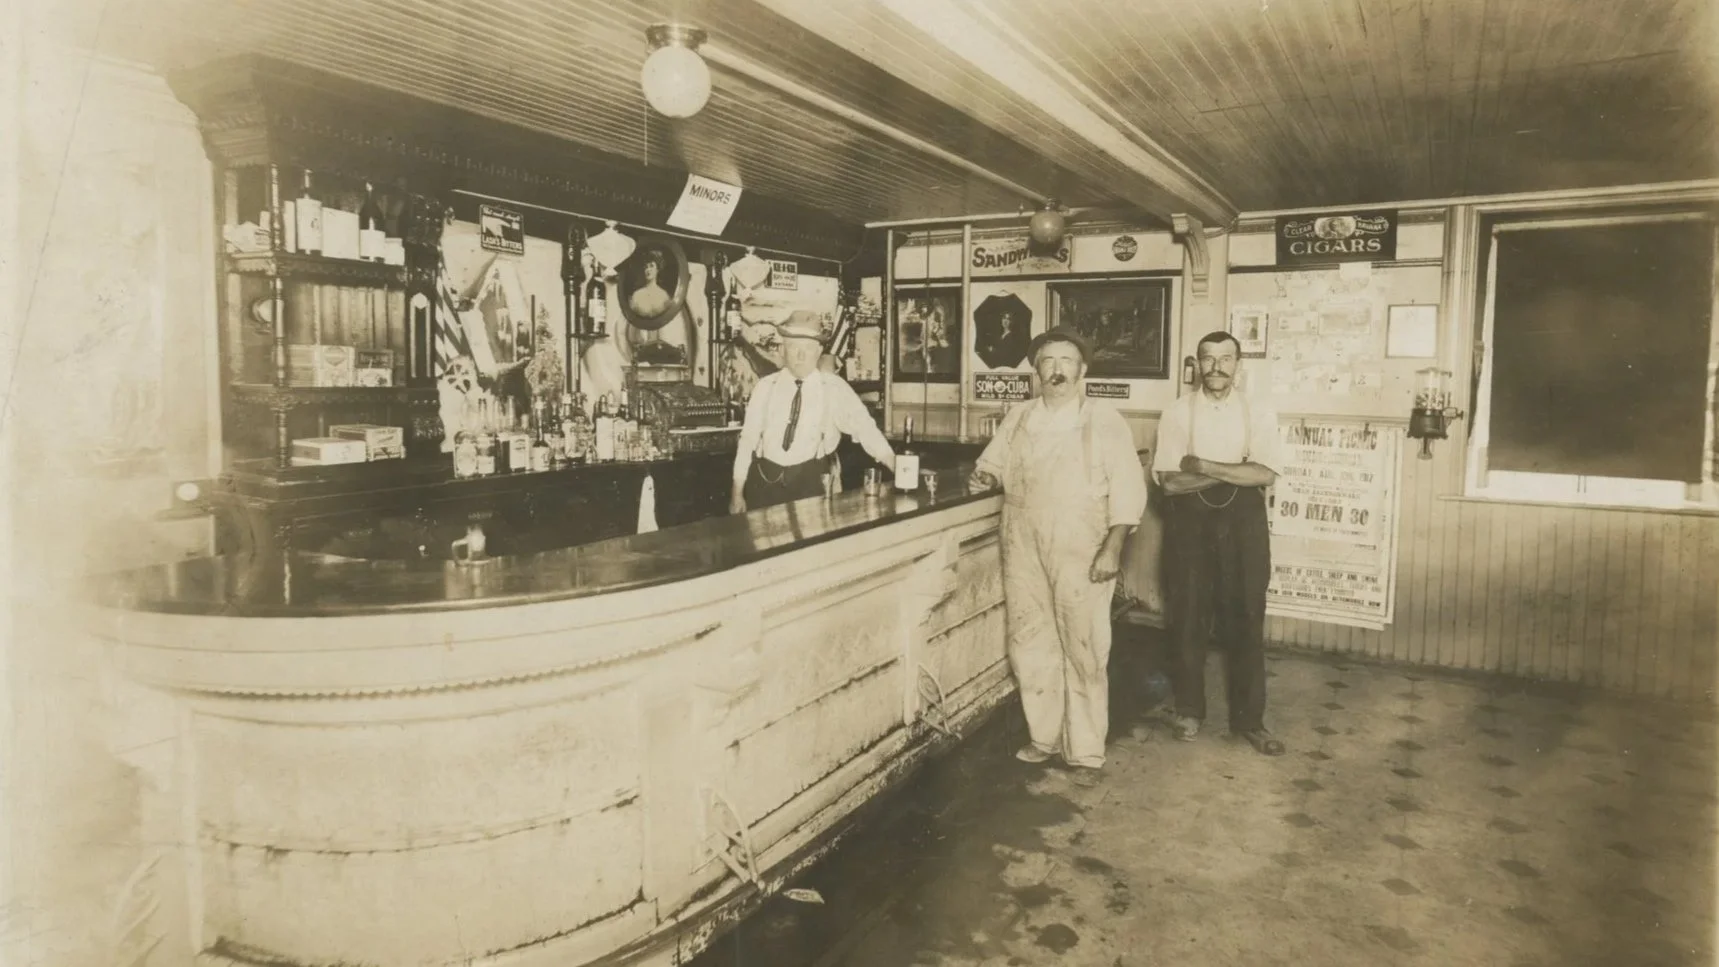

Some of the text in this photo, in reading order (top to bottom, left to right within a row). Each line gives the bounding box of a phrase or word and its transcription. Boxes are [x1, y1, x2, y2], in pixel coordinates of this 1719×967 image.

[689, 184, 732, 204] MINORS
[1291, 225, 1312, 235] CLEAR
[1289, 238, 1382, 255] CIGARS
[1007, 381, 1030, 393] CUBA
[1287, 425, 1377, 451] ANNUAL PICNIC
[1280, 500, 1369, 526] 30 MEN 30
